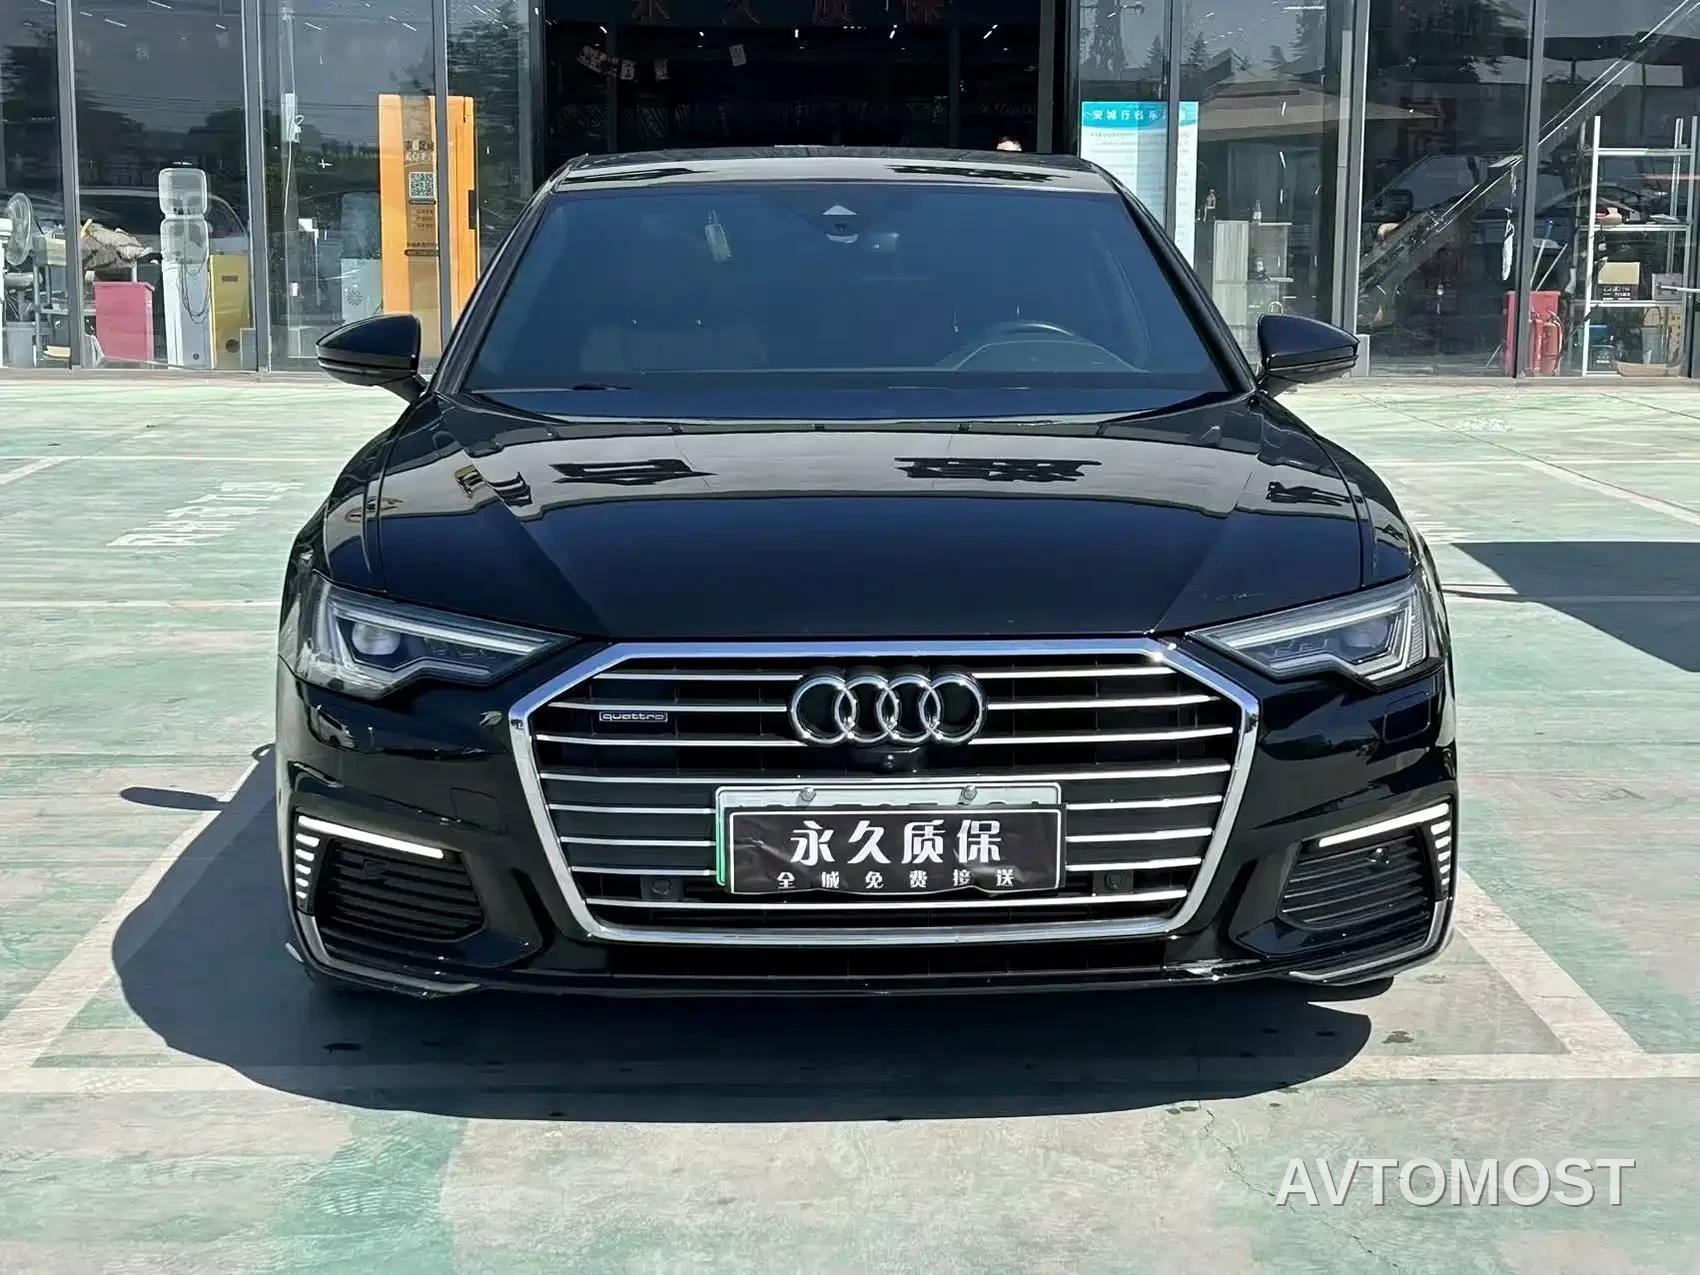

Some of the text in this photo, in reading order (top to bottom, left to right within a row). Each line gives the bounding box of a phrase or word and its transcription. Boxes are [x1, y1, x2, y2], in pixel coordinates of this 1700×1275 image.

[602, 712, 664, 721] quattro
[790, 819, 1002, 866] 永久质保
[776, 868, 1015, 889] 全城免费接送
